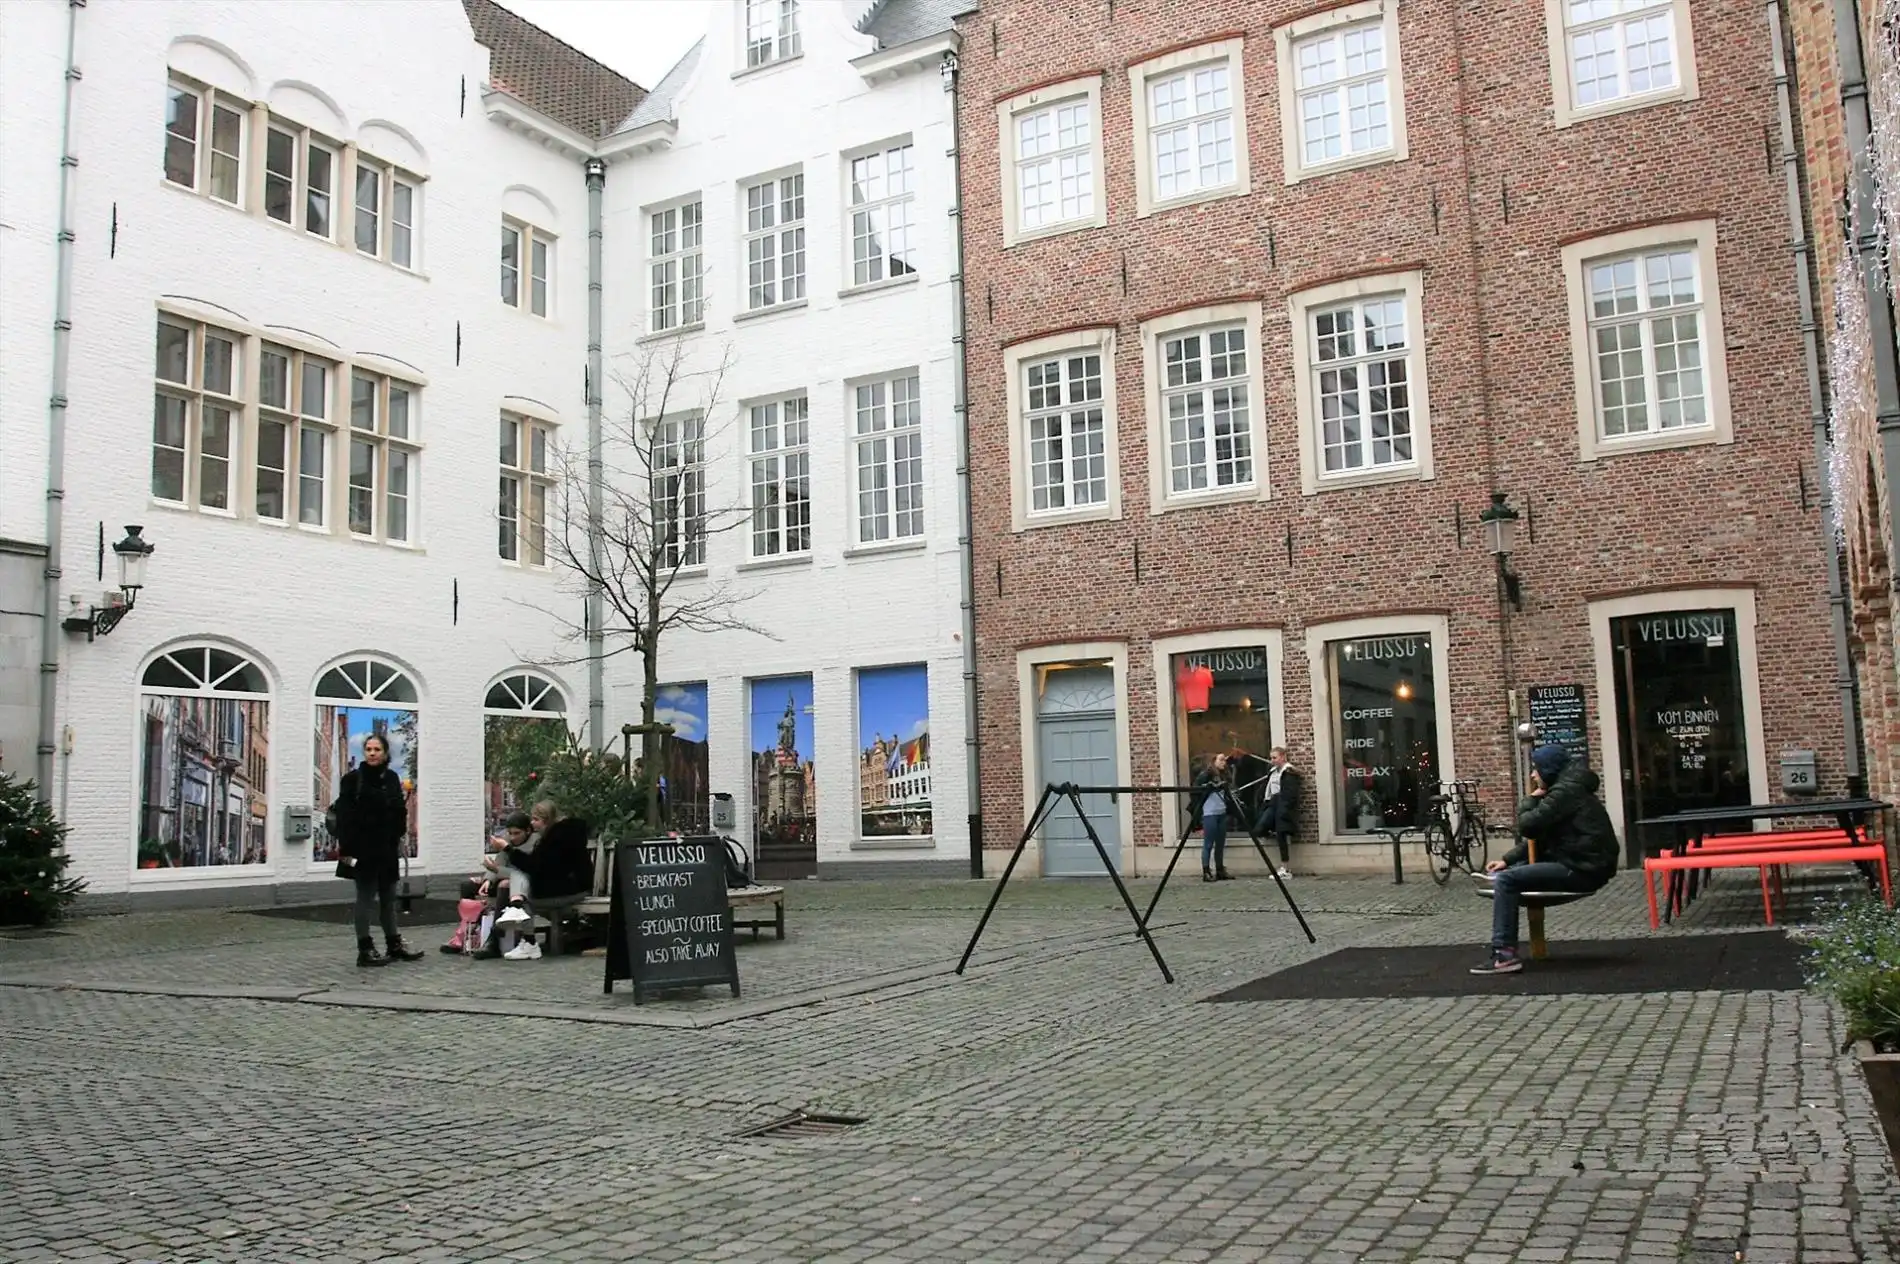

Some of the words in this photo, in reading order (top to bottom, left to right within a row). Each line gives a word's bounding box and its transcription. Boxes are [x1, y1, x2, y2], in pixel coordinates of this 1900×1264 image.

[1638, 616, 1725, 641] VELUSSO
[1188, 651, 1255, 673] VELUSSO
[1537, 686, 1576, 698] VELUSSO
[1343, 707, 1394, 720] COFFEE
[1657, 711, 1682, 725] KOM
[1684, 709, 1719, 724] BINNEN
[1345, 738, 1375, 749] RIDE
[1347, 766, 1391, 777] RELAX
[1791, 772, 1808, 783] 26
[637, 845, 706, 864] VELUSSO
[637, 872, 694, 889] BREAKFAST
[640, 894, 675, 911] LUNCH
[690, 914, 724, 933] COFFEE
[646, 949, 669, 964] ALSO
[671, 945, 693, 961] TAKE
[695, 942, 721, 958] AWAY
